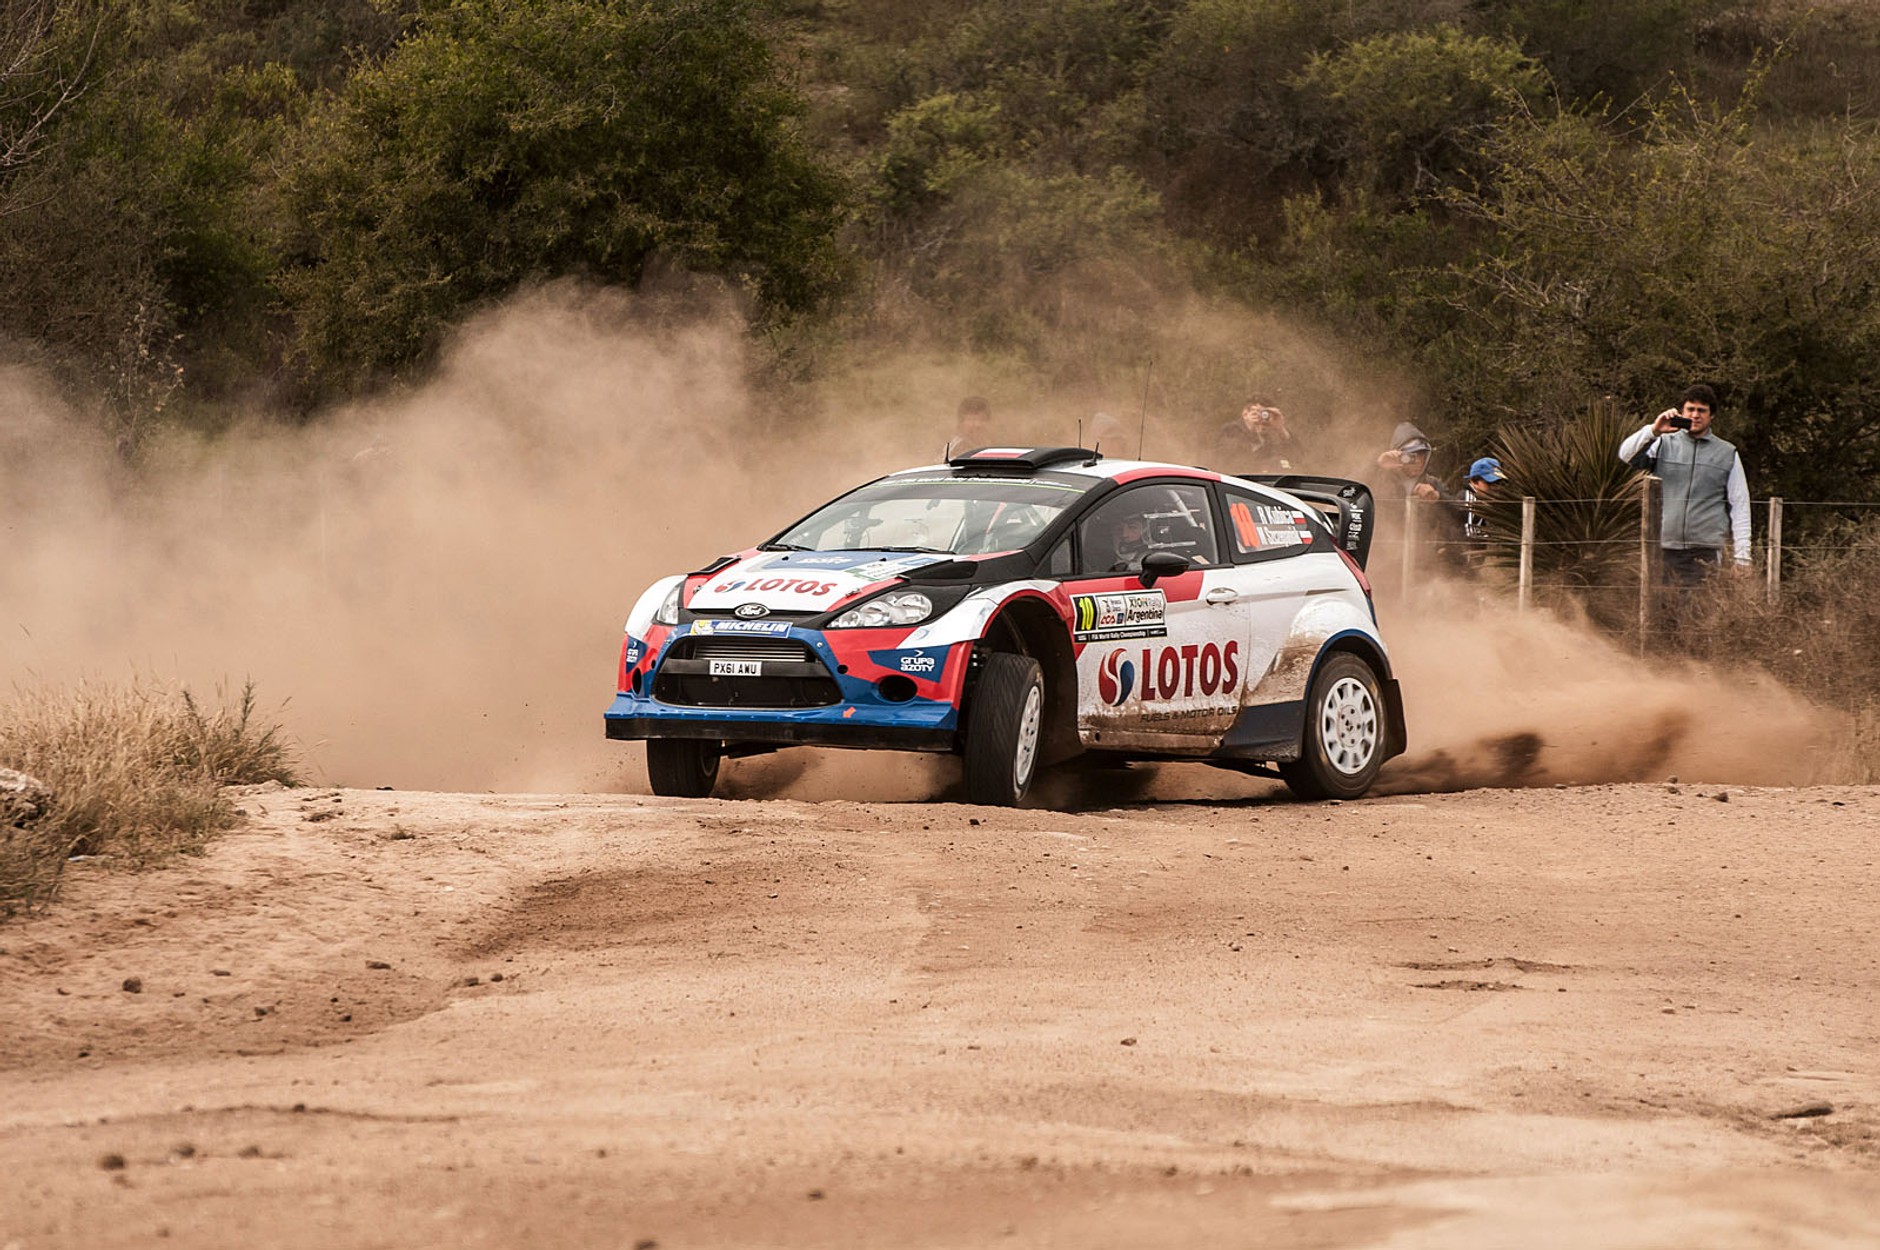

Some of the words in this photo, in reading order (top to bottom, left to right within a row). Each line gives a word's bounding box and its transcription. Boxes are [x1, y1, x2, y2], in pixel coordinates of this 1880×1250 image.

[1230, 503, 1260, 548] 10
[744, 578, 838, 596] LOTOS
[741, 605, 762, 615] Ford
[1079, 597, 1094, 631] 10
[1127, 608, 1163, 623] Argentina
[715, 621, 788, 632] MICHELIN
[714, 663, 735, 673] PX61
[738, 664, 757, 674] AWU
[1141, 640, 1238, 701] LOTOS
[1180, 707, 1214, 719] MOTOR
[1217, 706, 1237, 716] OILS
